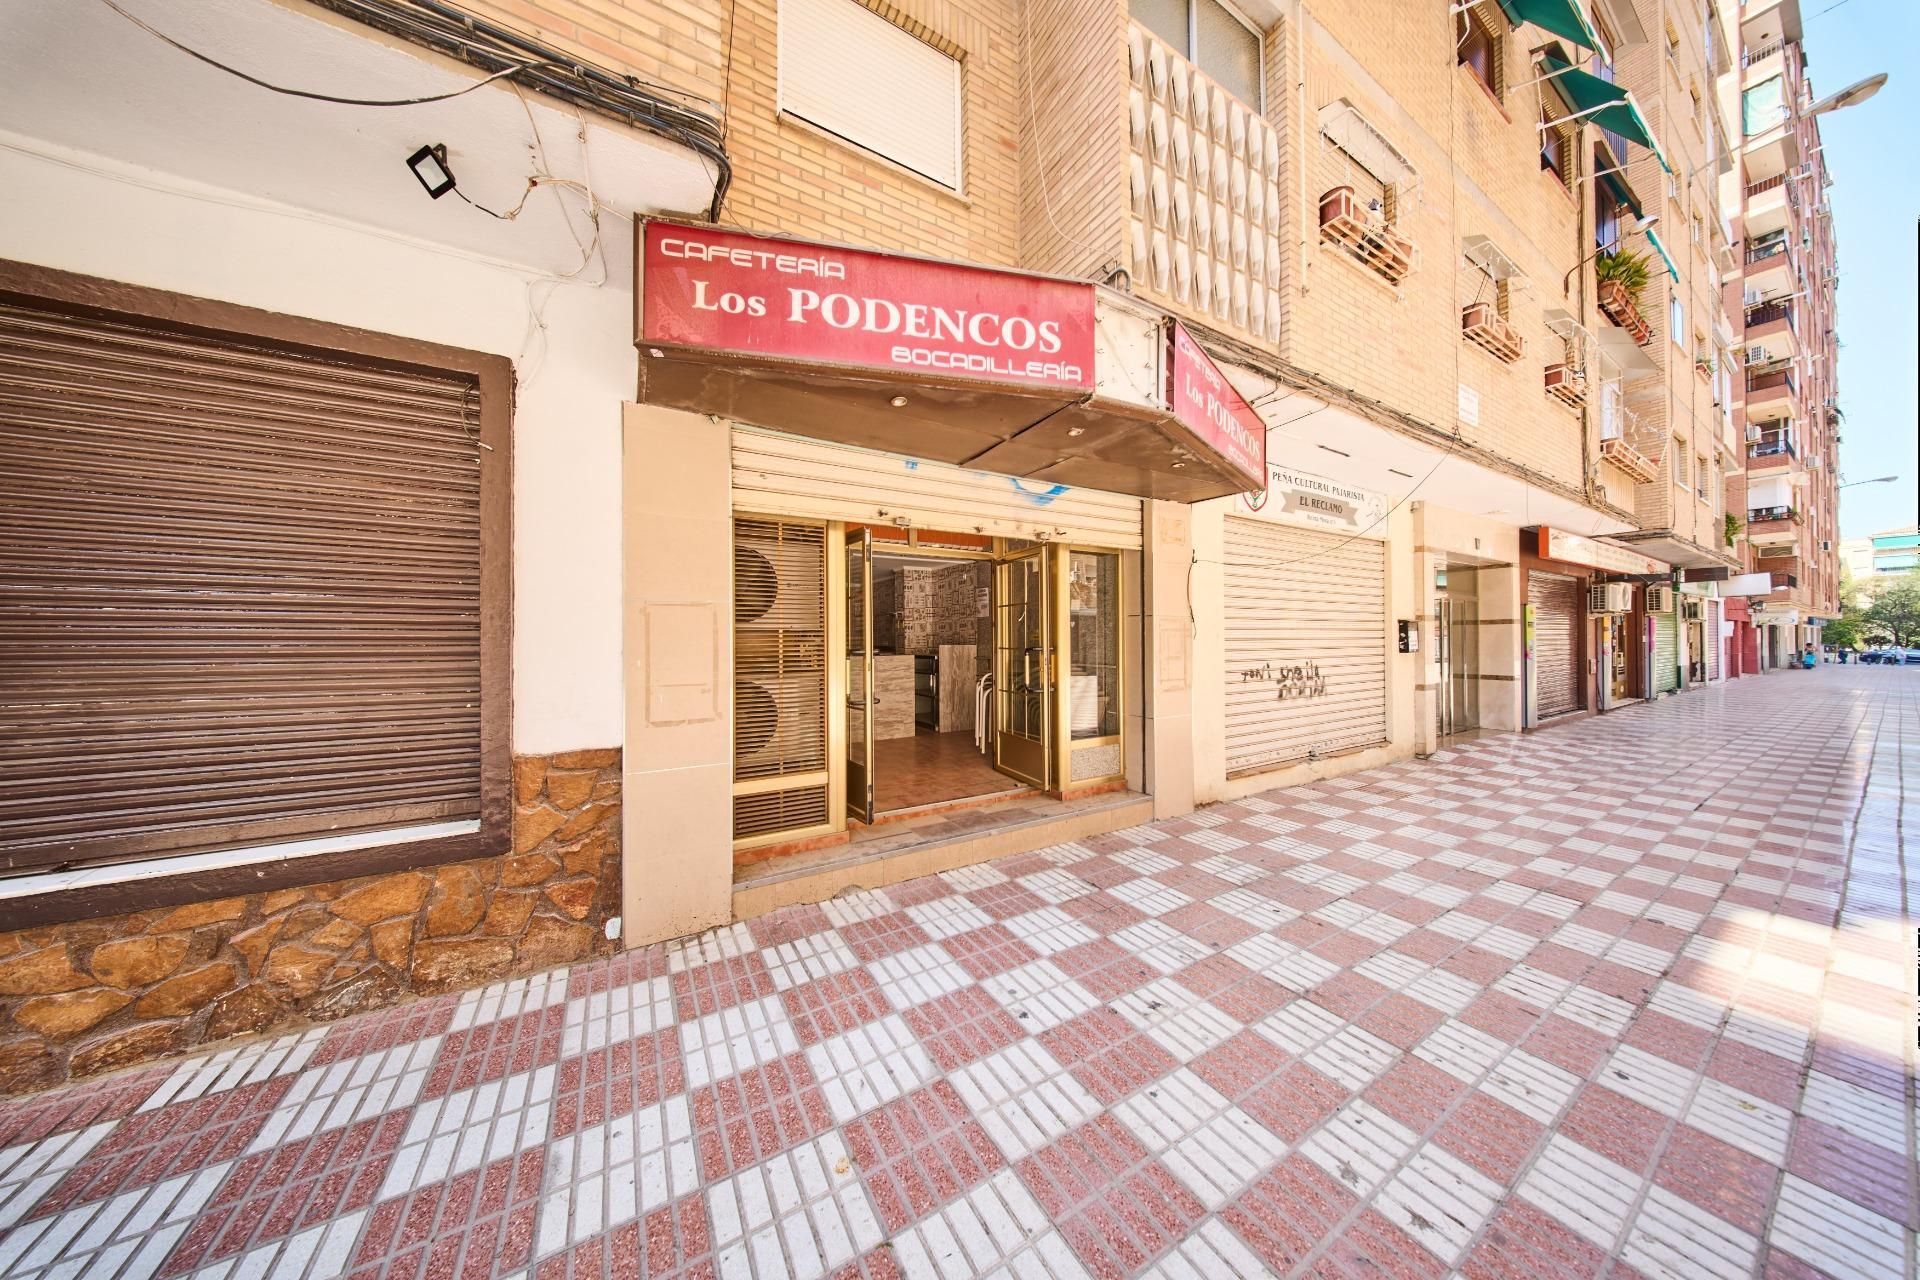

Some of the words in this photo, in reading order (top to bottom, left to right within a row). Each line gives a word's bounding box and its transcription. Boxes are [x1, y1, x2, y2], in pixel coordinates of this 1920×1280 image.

[660, 238, 846, 280] CAFETERÍA
[691, 279, 767, 317] Los
[786, 287, 1062, 354] PODENCOS
[890, 345, 1083, 383] BOCADILLERÍA
[1185, 372, 1204, 409] Los
[1207, 391, 1261, 462] PODENCOS
[1272, 471, 1293, 485] PEÑA
[1294, 476, 1330, 494] CULTURAL
[1299, 495, 1310, 507] EL
[1311, 498, 1344, 514] RECLAMO
